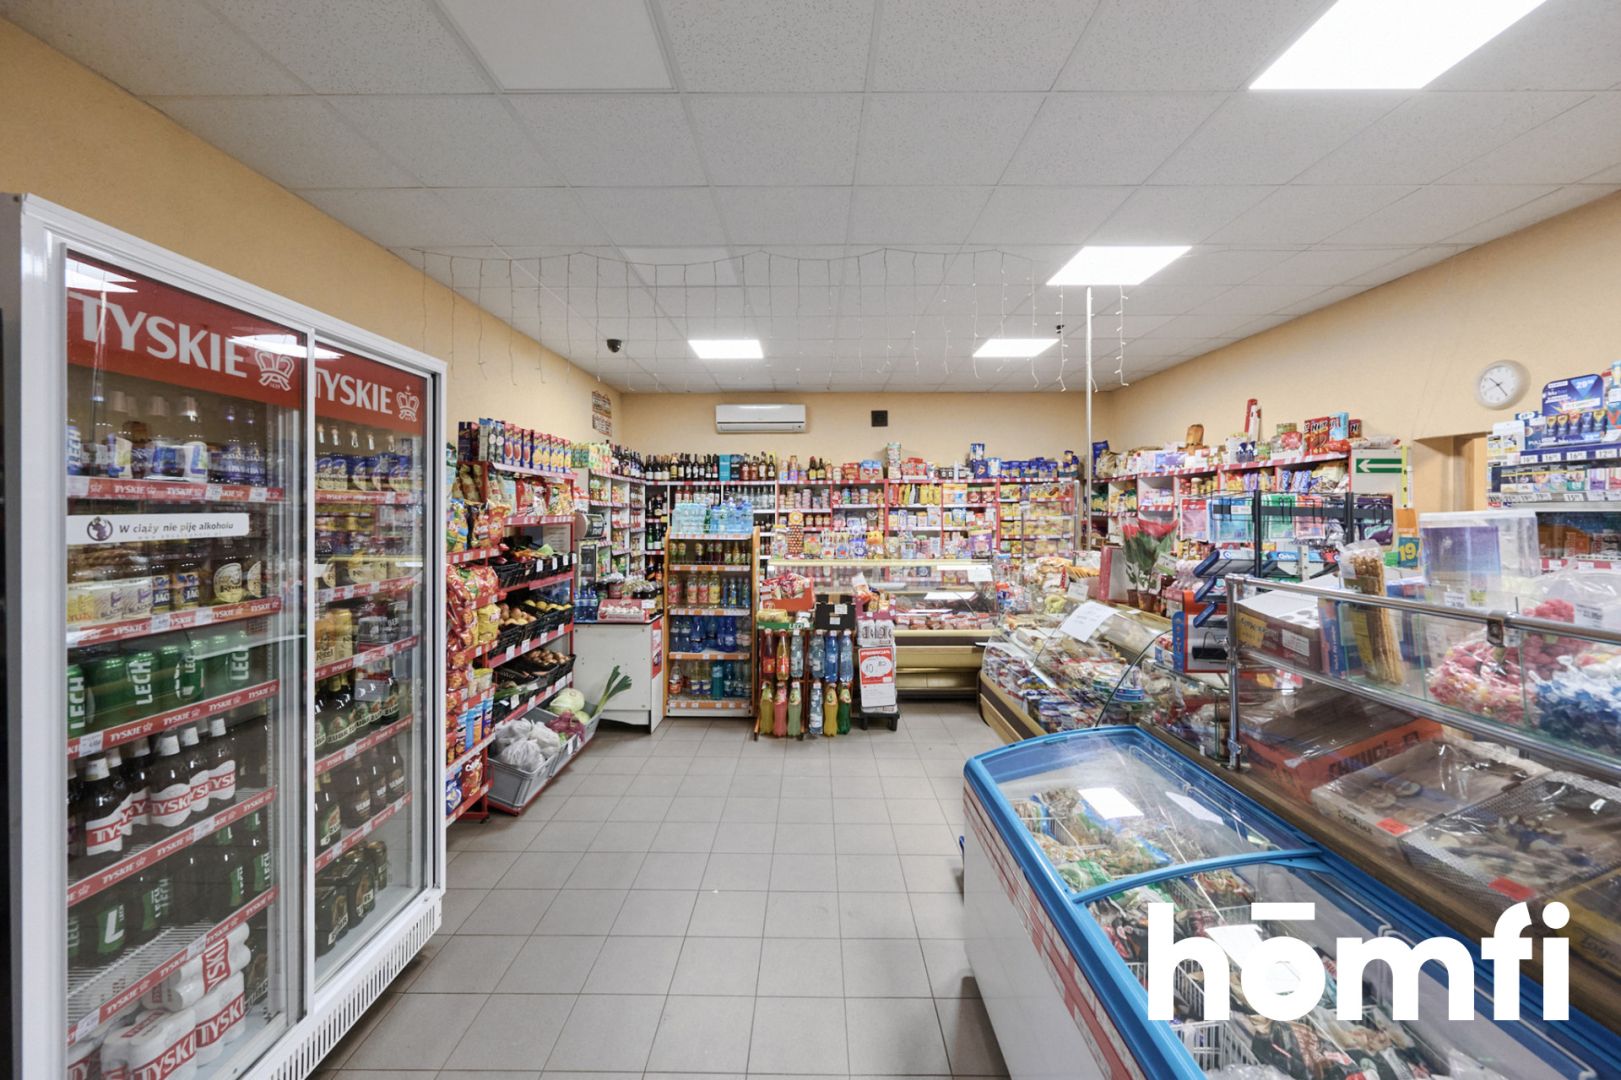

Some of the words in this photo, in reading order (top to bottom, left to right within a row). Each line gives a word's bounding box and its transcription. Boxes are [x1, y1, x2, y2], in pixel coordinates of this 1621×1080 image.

[67, 291, 248, 379] TYSKIE
[316, 367, 394, 415] TYSKIE
[119, 525, 130, 533] W
[133, 523, 159, 534] ciąży
[163, 523, 178, 532] nie
[1398, 543, 1418, 561] 19
[250, 603, 270, 612] TYSKIE
[170, 616, 193, 626] YSKIE
[112, 624, 143, 635] TYSKIE
[128, 660, 153, 705] LECH
[249, 688, 269, 699] TYSKIE
[69, 676, 86, 729] LECH
[208, 699, 232, 712] TYSKIE
[163, 712, 190, 726] TYSKIE
[110, 728, 141, 742] TYSKIE
[243, 797, 264, 812] TYSKIE
[157, 837, 184, 856] TYSKIE
[102, 863, 133, 885] TYSKIE
[159, 951, 187, 977] TYSKIE
[105, 988, 138, 1015] TYSKIE
